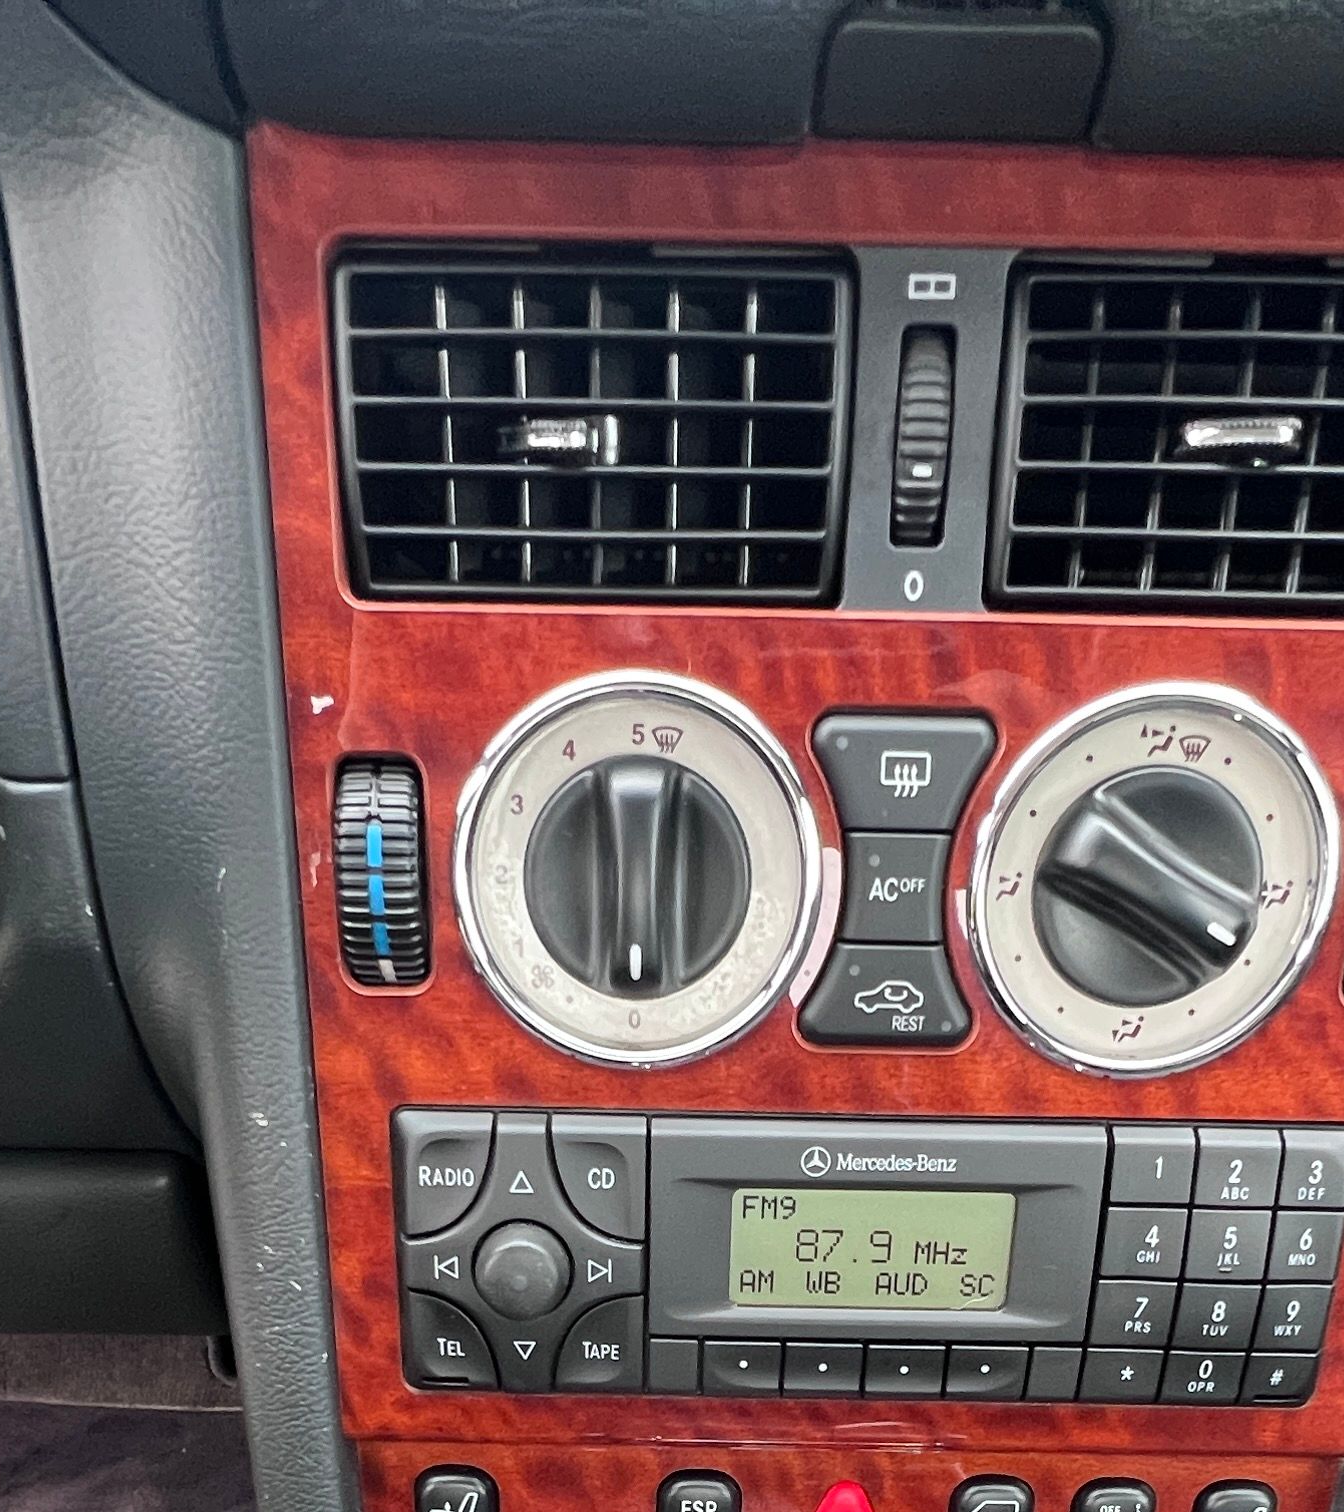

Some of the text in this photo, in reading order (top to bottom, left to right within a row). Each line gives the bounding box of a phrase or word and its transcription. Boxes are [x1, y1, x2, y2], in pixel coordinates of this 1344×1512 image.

[904, 569, 925, 602] 0
[631, 723, 646, 746] 5
[561, 739, 578, 761] 4
[510, 795, 524, 817] 3
[628, 1009, 642, 1030] 0
[891, 1015, 925, 1033] REST
[835, 1152, 957, 1174] Mercedes-Benz
[1155, 1155, 1164, 1180] 1
[1228, 1159, 1244, 1184] 2
[1308, 1159, 1324, 1185] 3
[418, 1165, 475, 1188] RADIO
[587, 1167, 616, 1190] CD
[1220, 1186, 1250, 1201] ABC
[1297, 1186, 1326, 1201] DEF
[741, 1195, 797, 1220] FM9
[795, 1228, 968, 1266] 87.9 MHz
[1144, 1224, 1160, 1249] 4
[1222, 1226, 1238, 1250] 5
[1299, 1228, 1313, 1251] 6
[1136, 1250, 1161, 1264] GHI
[1216, 1251, 1241, 1267] JKL
[1287, 1253, 1316, 1267] MNO
[739, 1269, 996, 1298] AM WB AUD SC
[1133, 1297, 1149, 1319] 7
[1211, 1301, 1226, 1323] 8
[1286, 1300, 1301, 1323] 9
[1124, 1320, 1152, 1334] PRS
[1201, 1324, 1229, 1337] TUV
[1273, 1324, 1302, 1337] WXY
[436, 1338, 465, 1357] TEL
[582, 1341, 620, 1361] TAPE
